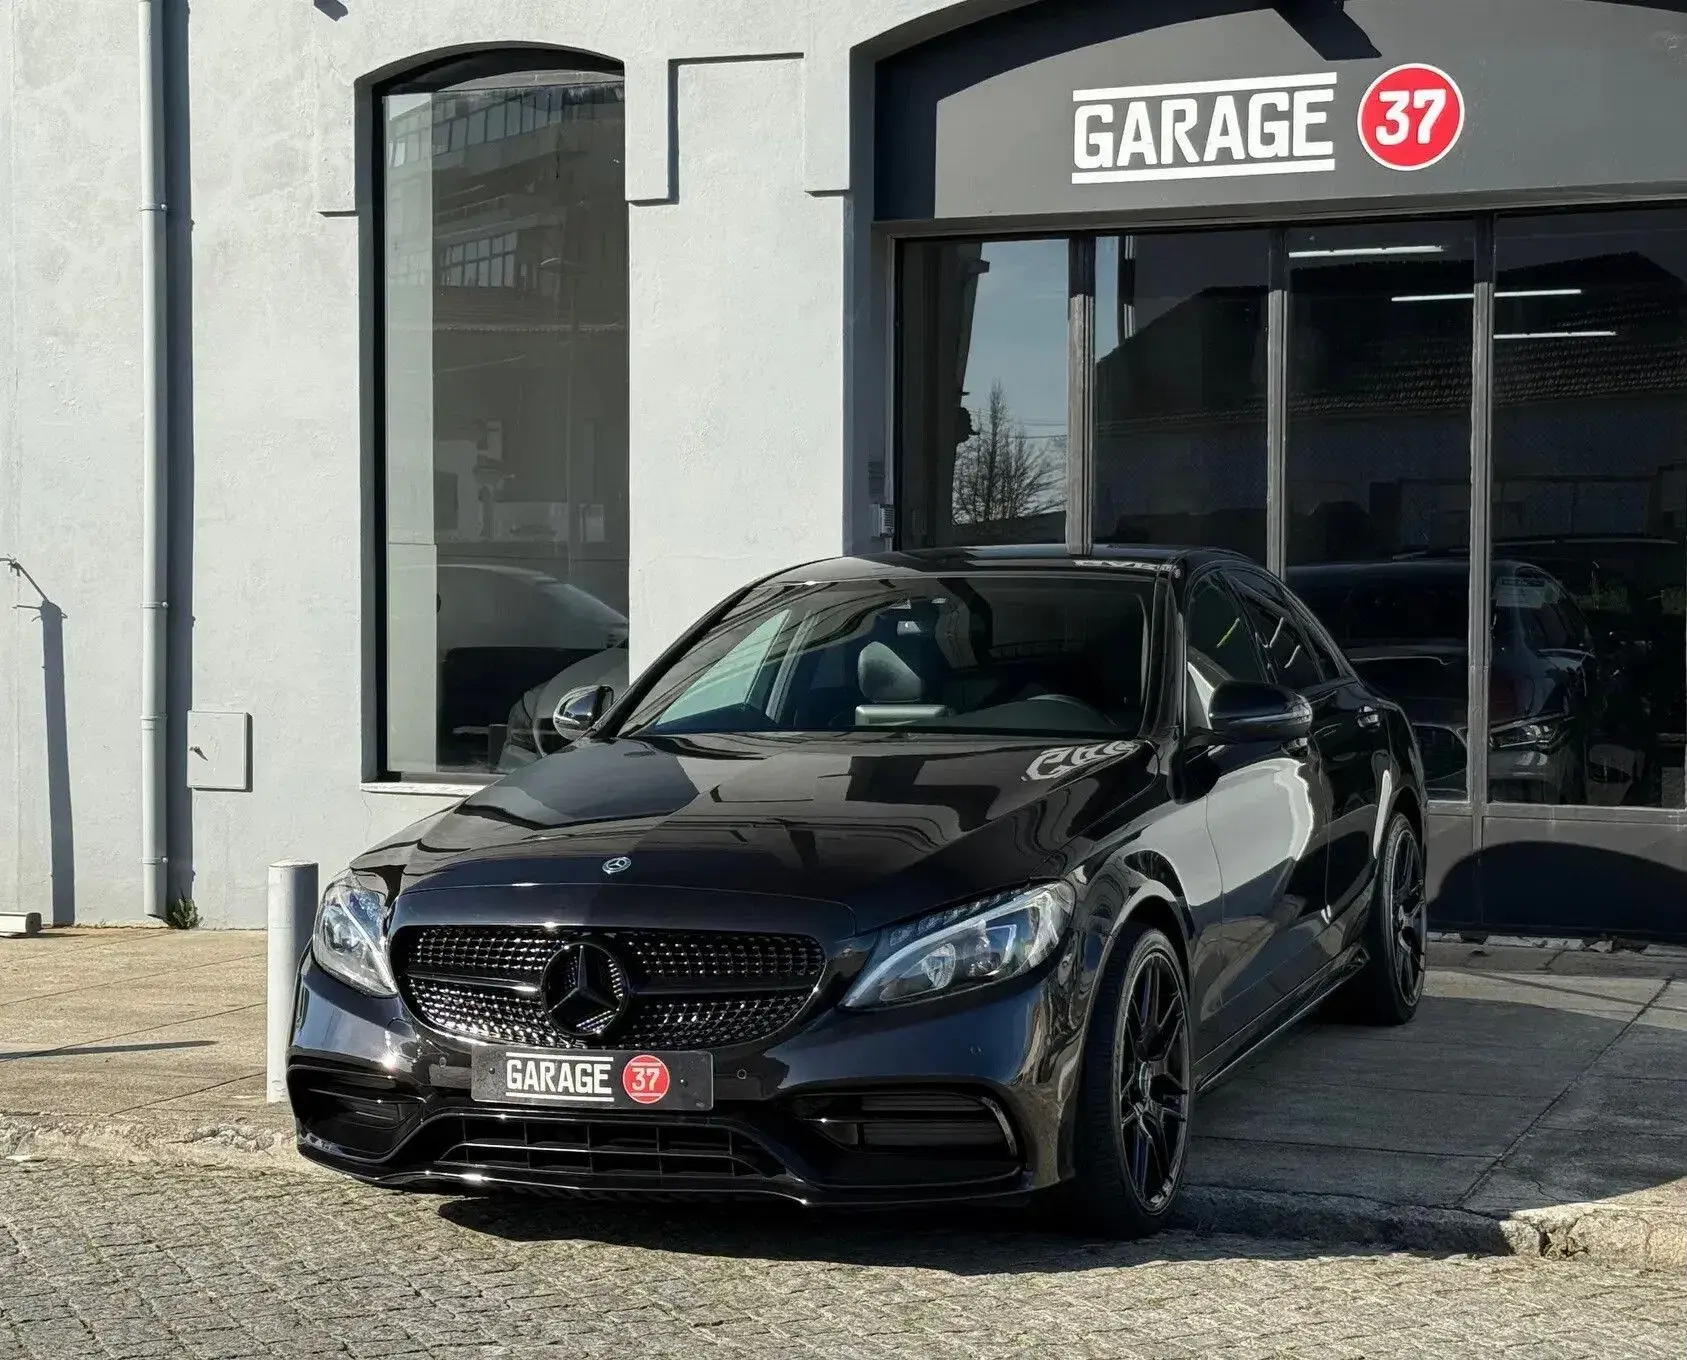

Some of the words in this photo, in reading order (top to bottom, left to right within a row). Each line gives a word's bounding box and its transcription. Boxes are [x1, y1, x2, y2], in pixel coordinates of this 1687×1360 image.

[1073, 88, 1335, 170] GARAGE
[1375, 88, 1447, 146] 37
[506, 1059, 613, 1095] GARAGE
[632, 1067, 660, 1091] 37
